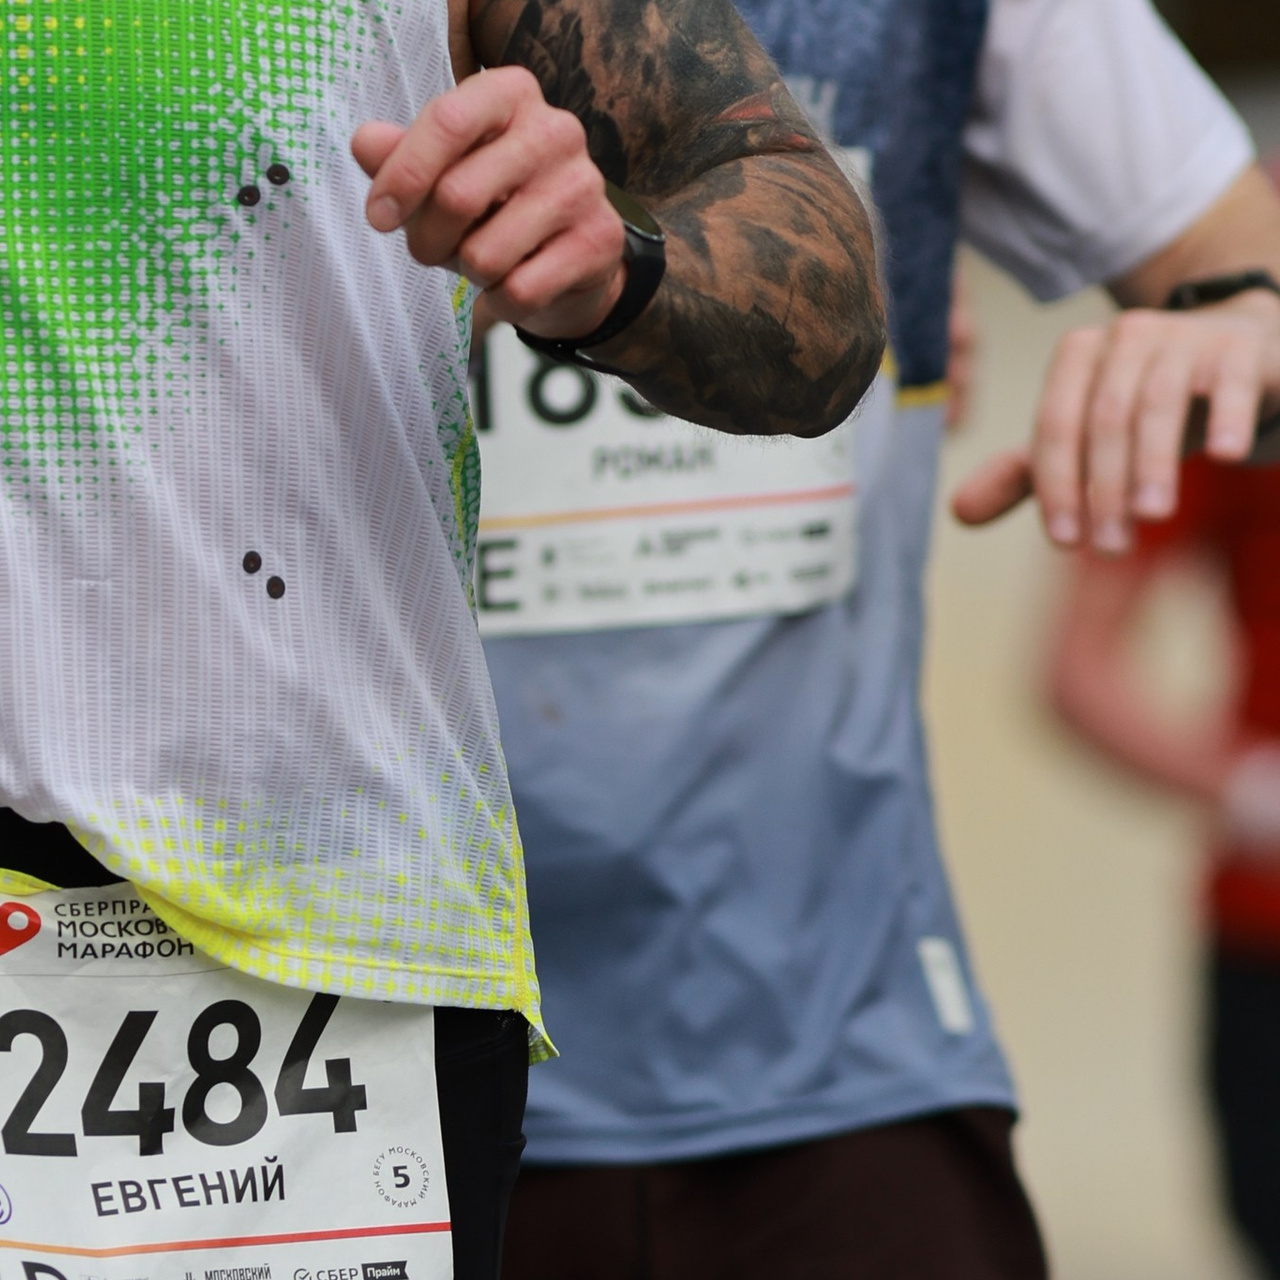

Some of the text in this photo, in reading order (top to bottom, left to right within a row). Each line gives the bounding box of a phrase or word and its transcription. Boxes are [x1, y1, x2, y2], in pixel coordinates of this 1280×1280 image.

[57, 918, 177, 938] МОСКОВ
[57, 938, 195, 959] МАРАФОН
[91, 1156, 286, 1218] ЕВГЕНИЙ
[392, 1165, 411, 1188] 5
[367, 1264, 401, 1279] Прайм
